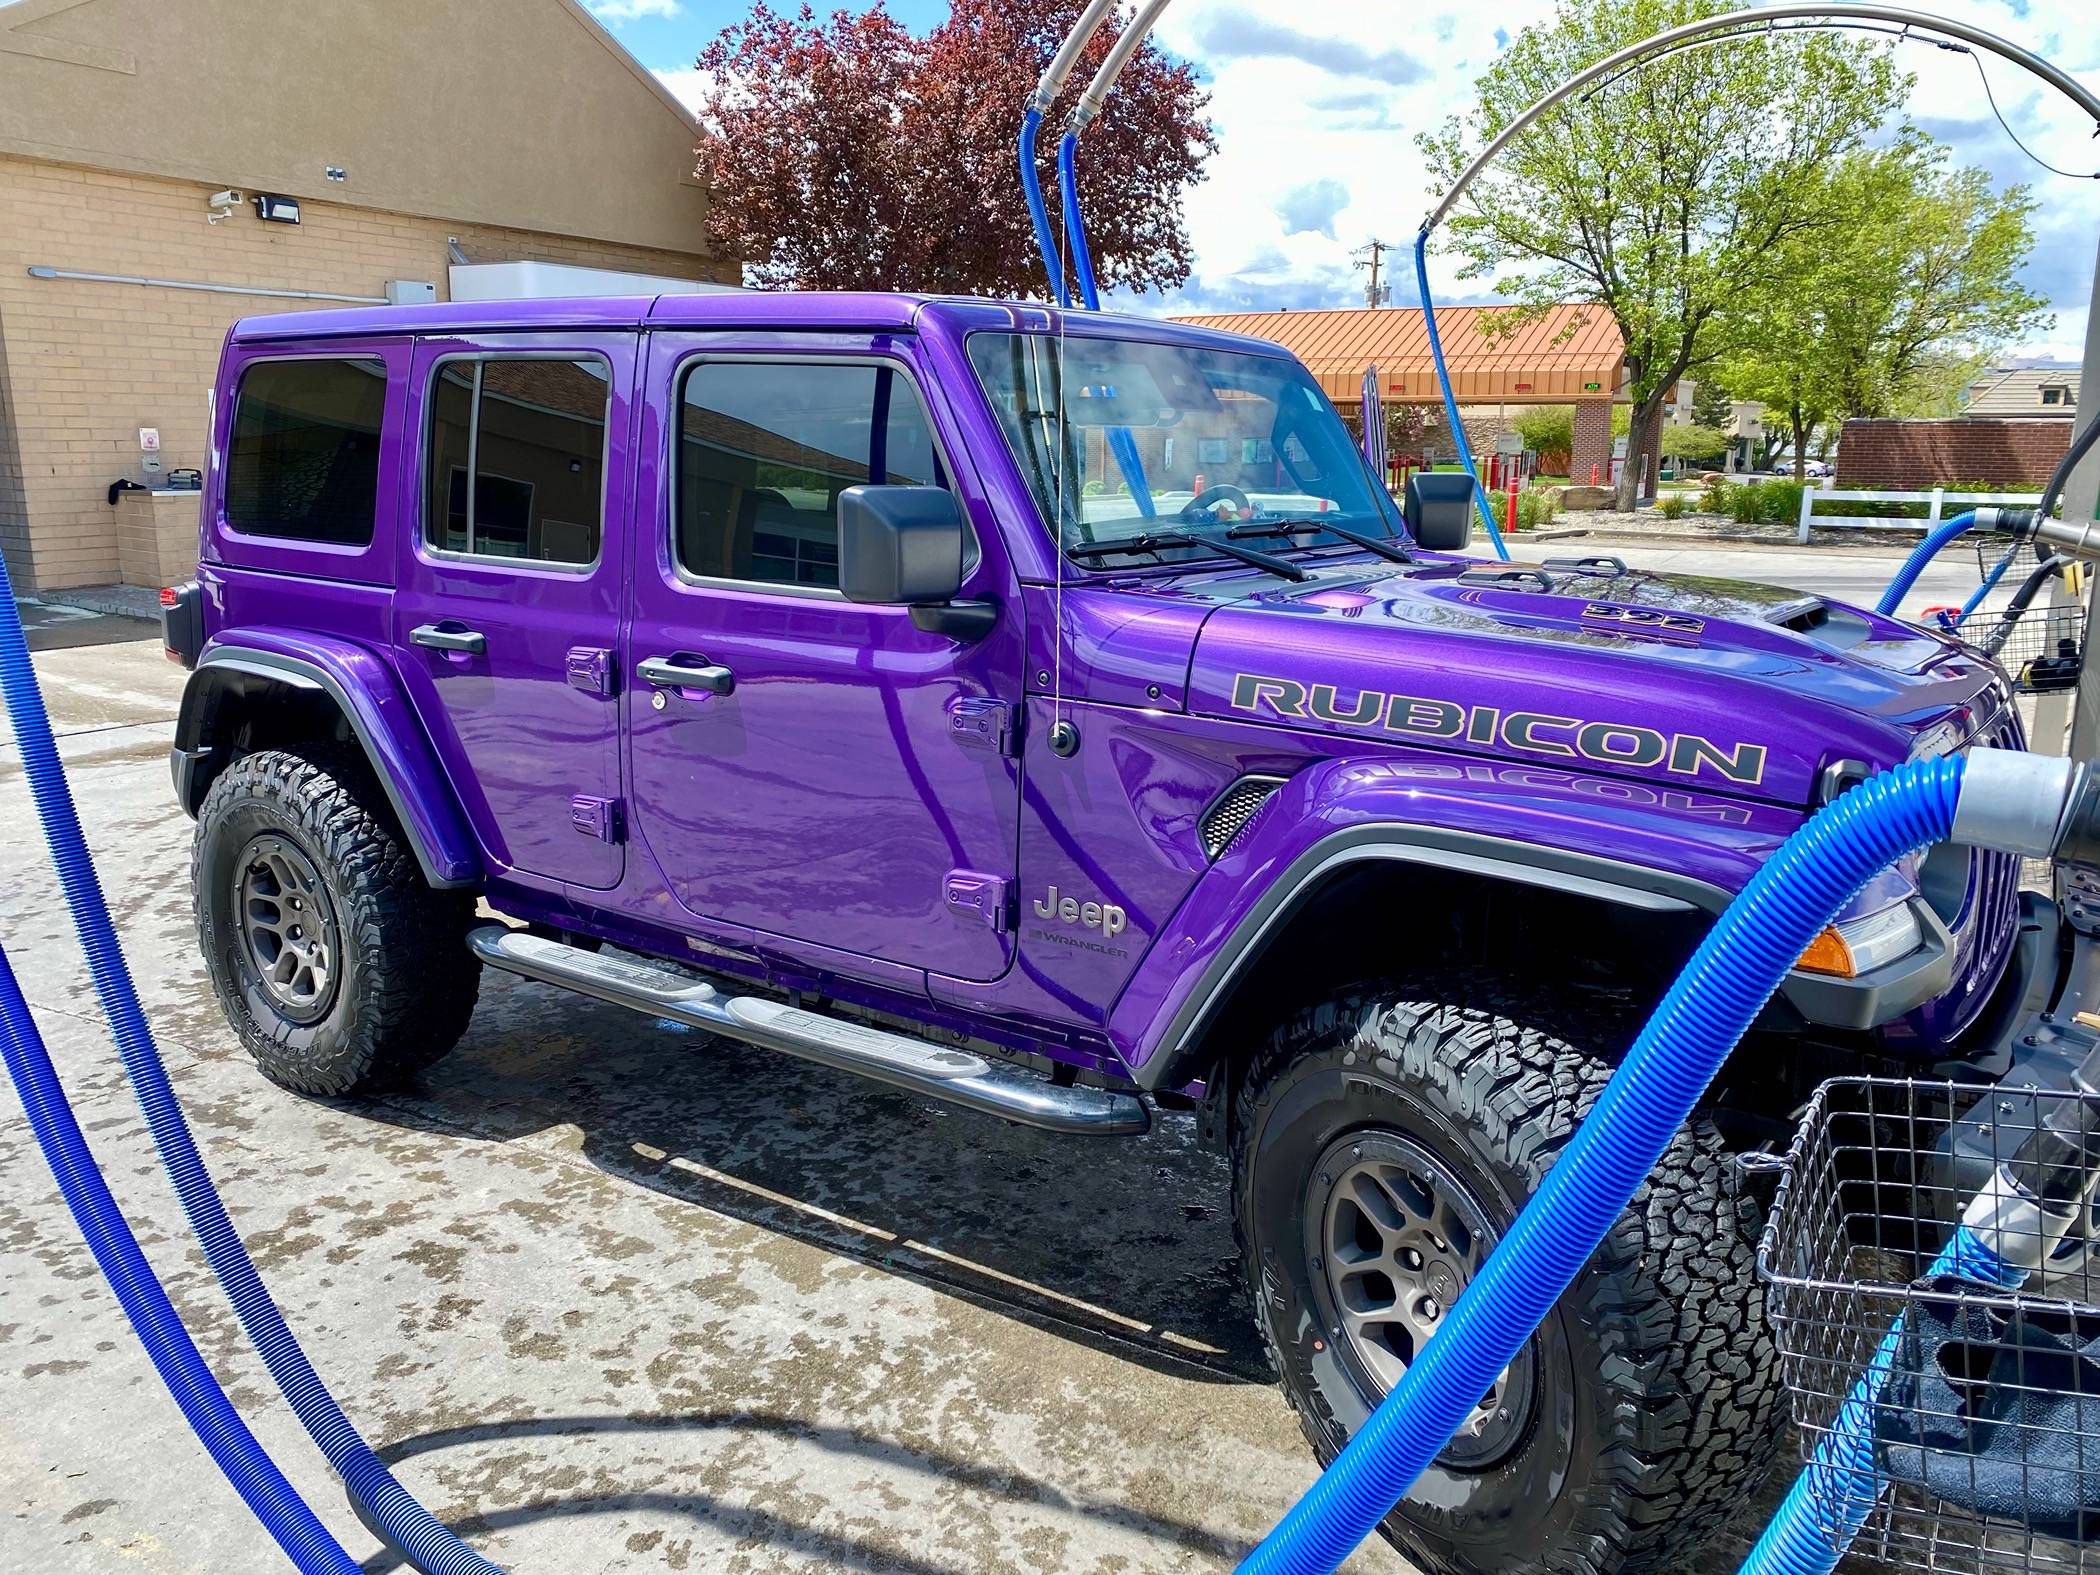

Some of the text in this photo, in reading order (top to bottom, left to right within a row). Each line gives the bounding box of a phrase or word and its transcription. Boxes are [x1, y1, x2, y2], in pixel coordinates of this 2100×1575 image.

[1581, 603, 1706, 634] 392
[1230, 672, 1767, 785] RUBICON
[1033, 885, 1127, 938] Jeep
[1042, 930, 1129, 959] WRANGLER
